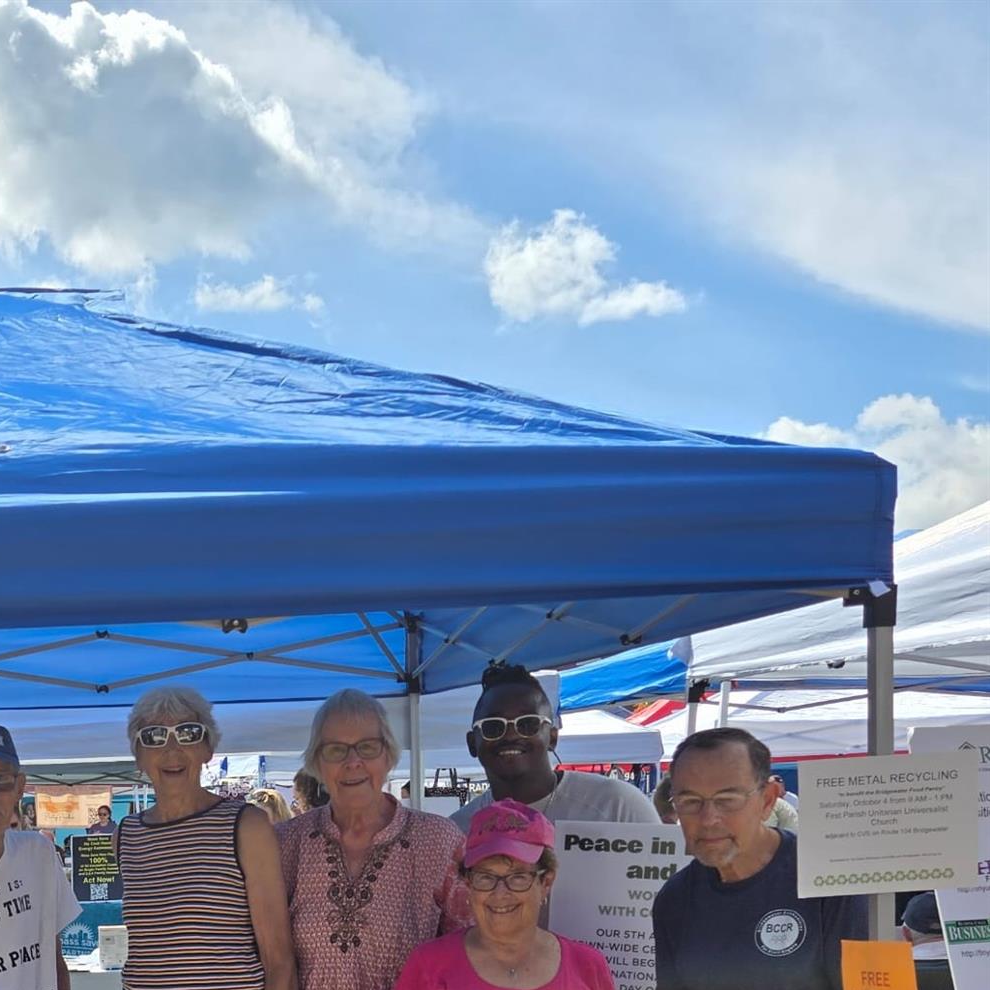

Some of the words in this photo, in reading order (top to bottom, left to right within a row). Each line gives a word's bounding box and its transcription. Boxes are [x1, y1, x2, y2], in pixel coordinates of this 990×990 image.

[816, 777, 846, 788] FREE
[848, 774, 887, 787] METAL
[890, 769, 959, 783] RECYCLING
[853, 797, 881, 807] October
[825, 811, 842, 820] First
[843, 809, 867, 819] Parish
[868, 807, 903, 818] Unitarian
[904, 804, 949, 815] Universalist
[870, 817, 899, 827] Church
[564, 834, 644, 854] Peace
[651, 837, 676, 855] in
[90, 856, 109, 864] 100%
[7, 880, 24, 892] IS:
[598, 904, 636, 918] WITH
[596, 928, 621, 938] OUR
[623, 930, 646, 940] 5TH
[765, 922, 794, 934] BCCR
[632, 958, 655, 968] BEG
[861, 971, 890, 987] FREE
